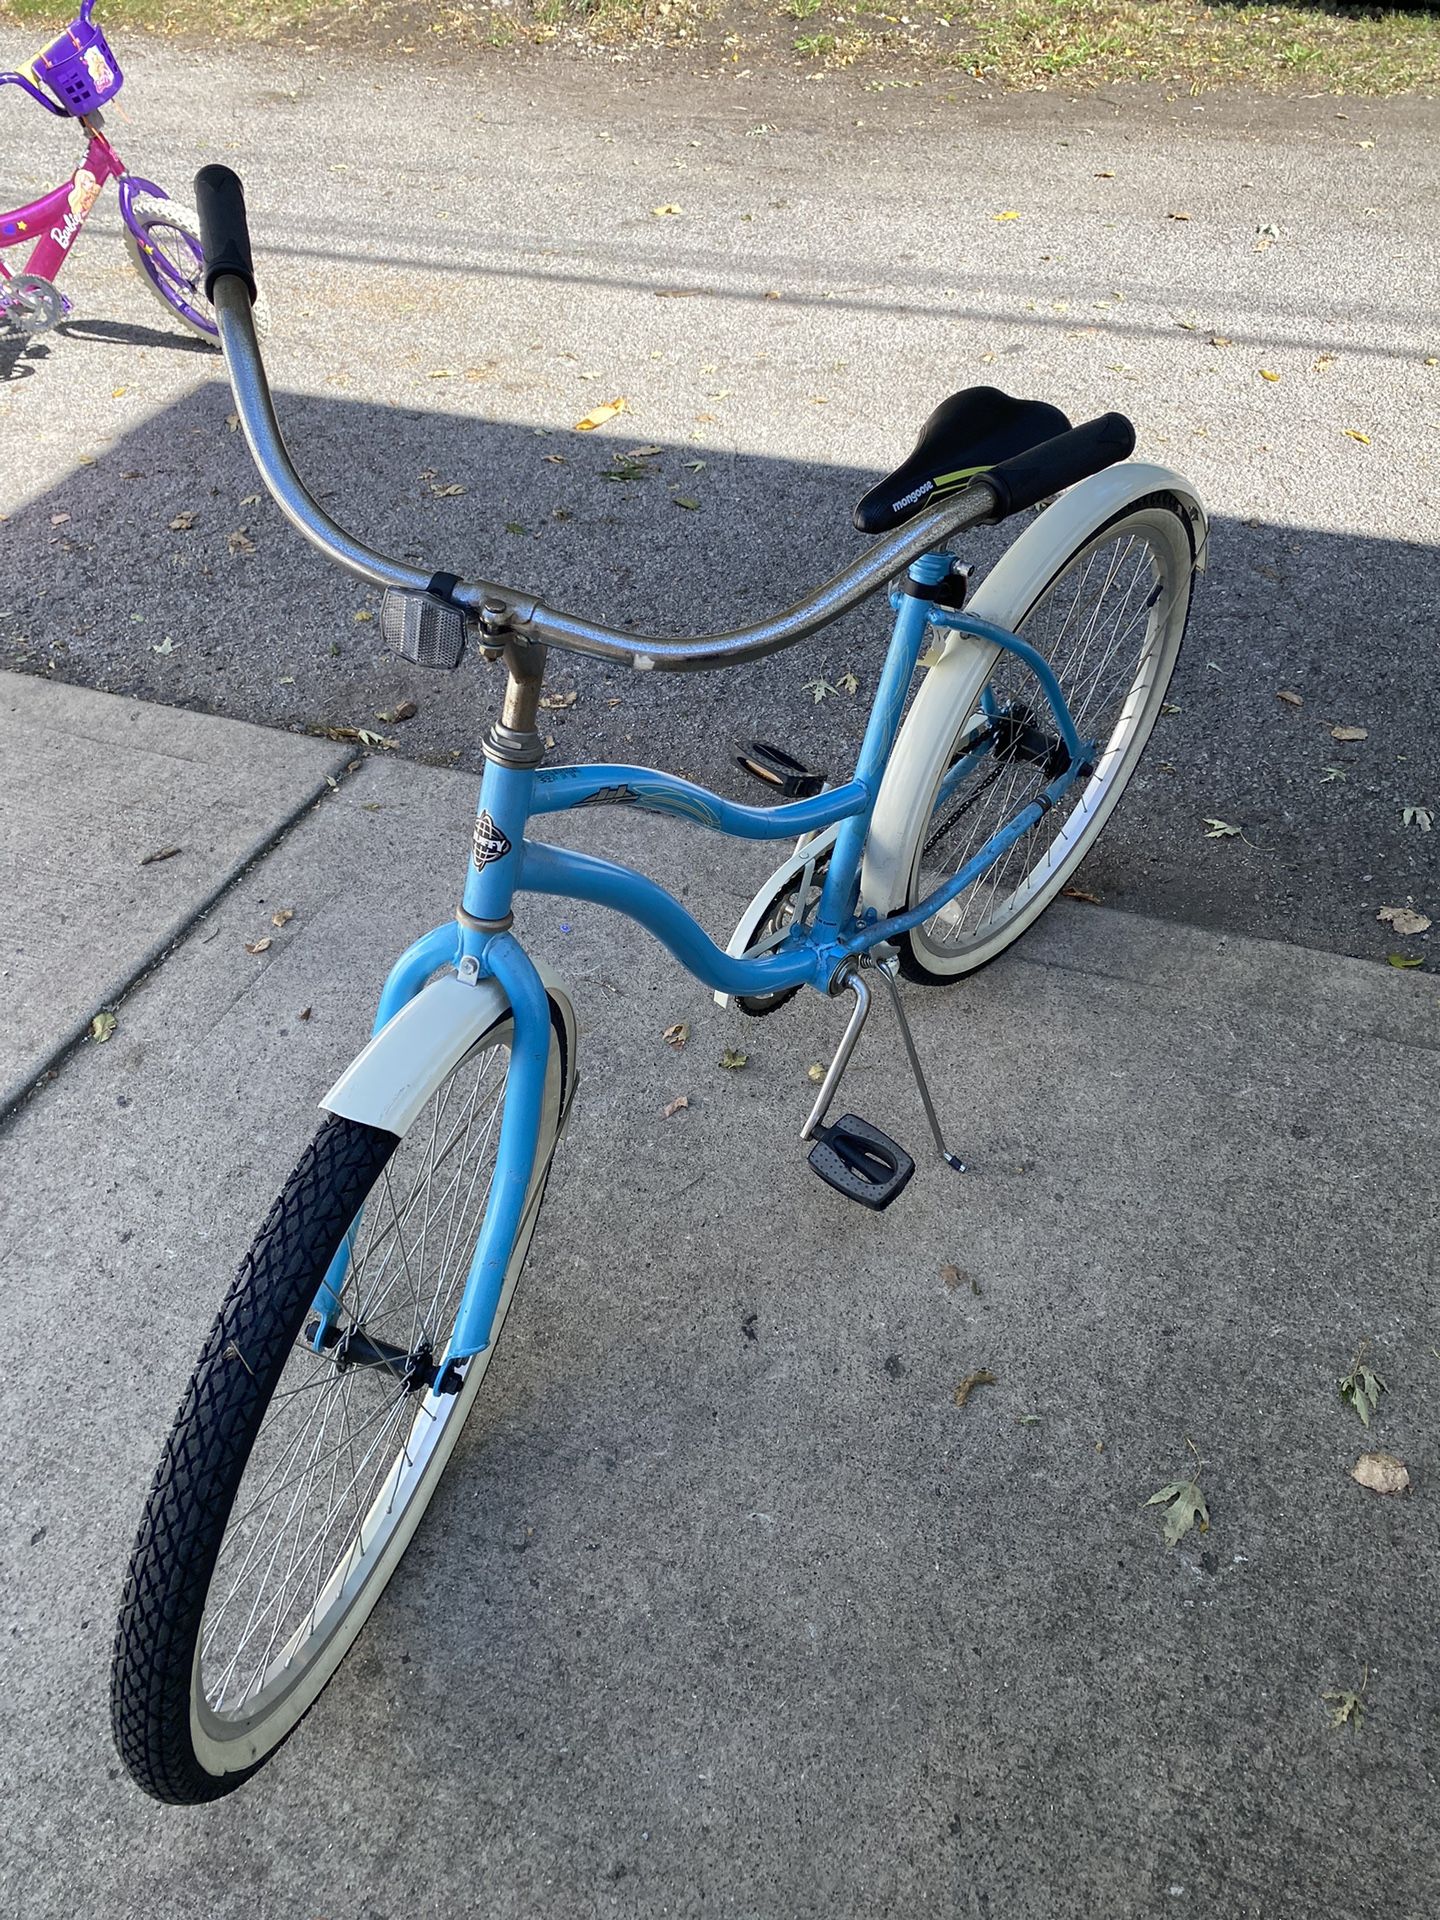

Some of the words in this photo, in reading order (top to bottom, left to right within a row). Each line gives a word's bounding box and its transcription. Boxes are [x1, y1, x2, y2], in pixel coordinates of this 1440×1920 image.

[50, 212, 82, 250] Barbie
[892, 480, 934, 512] mongoose
[473, 829, 506, 852] UFFY
